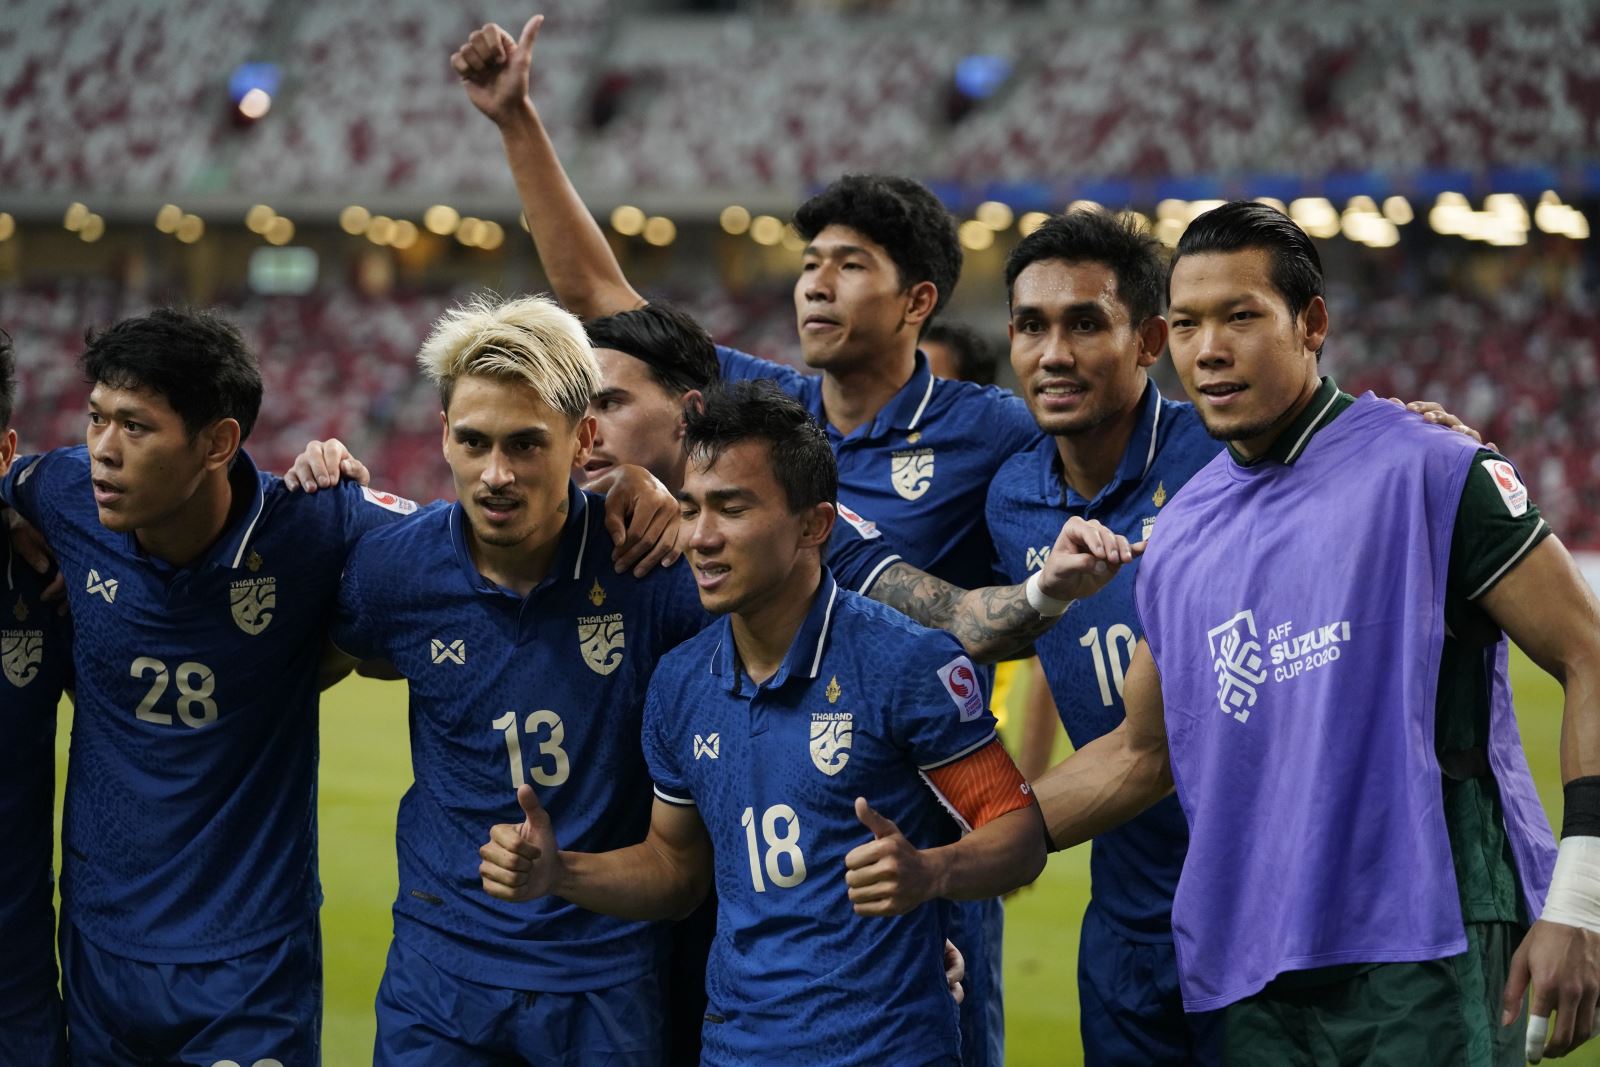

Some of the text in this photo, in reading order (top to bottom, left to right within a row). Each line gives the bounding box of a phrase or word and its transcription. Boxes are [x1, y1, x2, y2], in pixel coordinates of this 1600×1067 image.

[230, 577, 276, 588] THAILAND
[577, 613, 623, 624] THAILAND
[1268, 621, 1292, 644] AFF
[1270, 621, 1351, 665] SUZUKI
[1275, 645, 1340, 683] CUP 2020
[130, 656, 219, 728] 28
[811, 712, 853, 721] THAILAND
[492, 709, 570, 789] 13
[741, 804, 807, 892] 18
